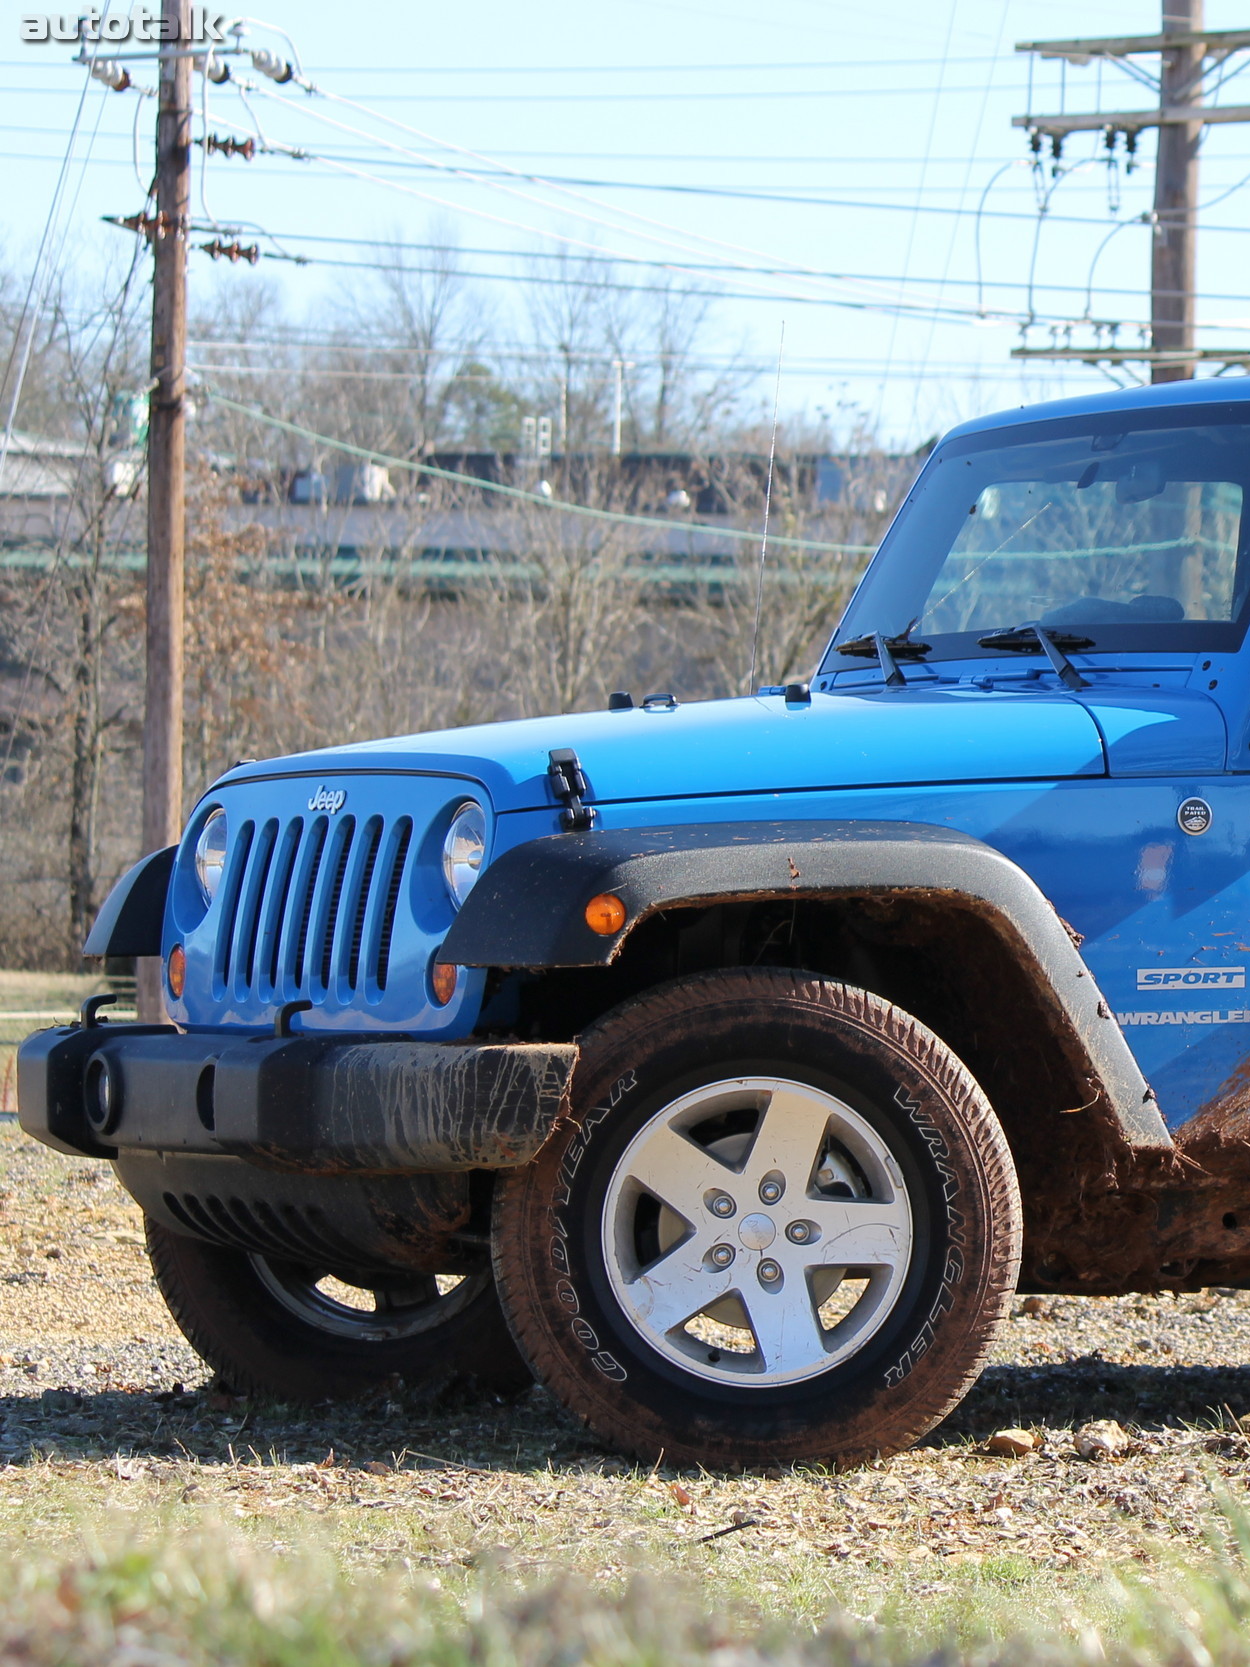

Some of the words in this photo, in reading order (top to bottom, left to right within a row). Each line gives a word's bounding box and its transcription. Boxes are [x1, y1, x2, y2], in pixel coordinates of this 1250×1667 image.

[308, 785, 346, 814] Jeep
[1139, 971, 1244, 987] SPORT
[548, 1069, 638, 1382] GOODYEAR
[884, 1084, 967, 1388] WRANGLER
